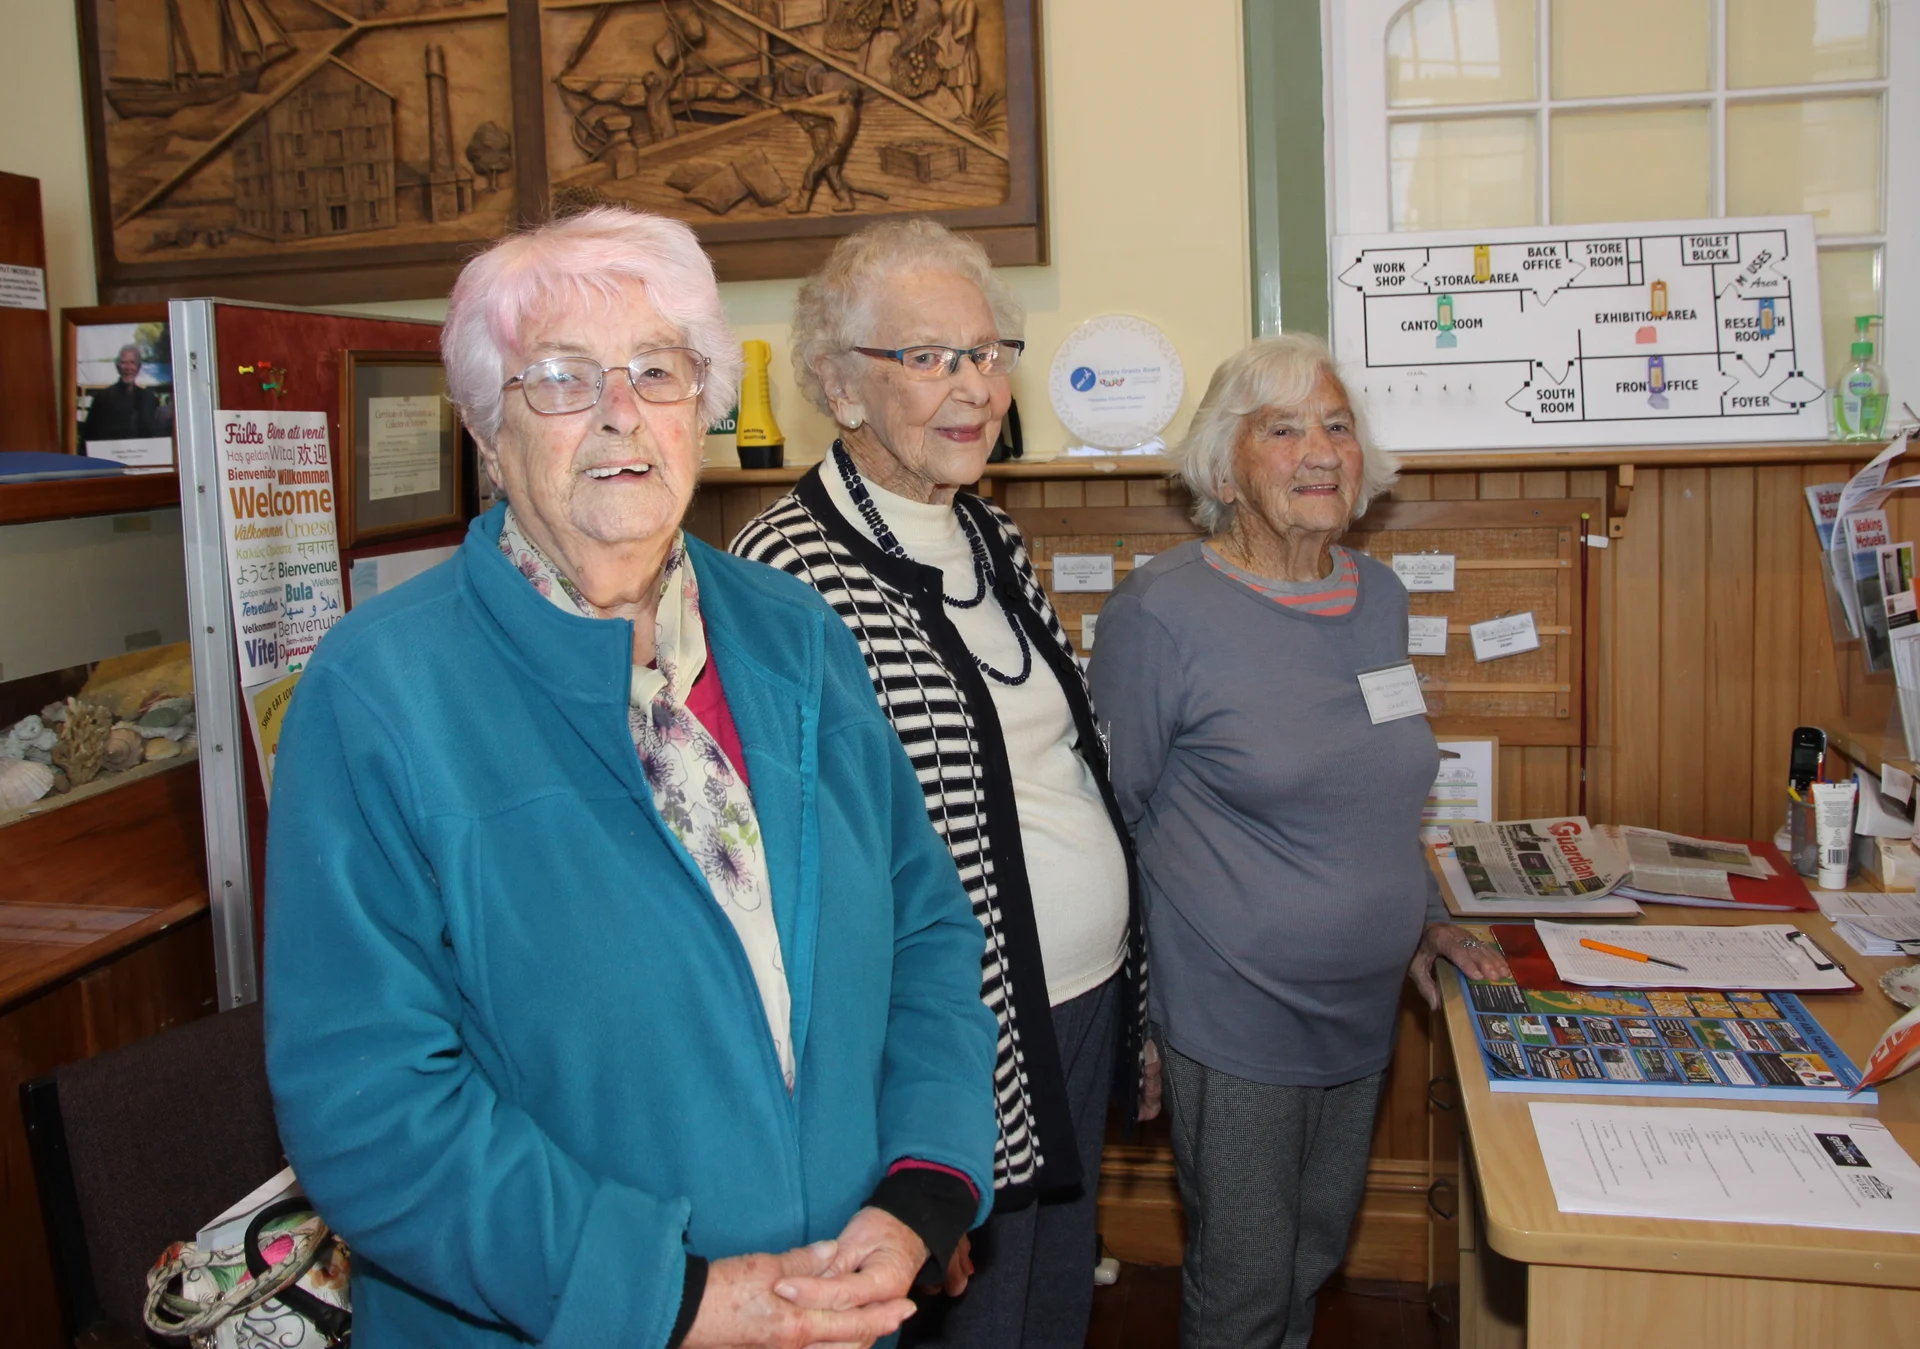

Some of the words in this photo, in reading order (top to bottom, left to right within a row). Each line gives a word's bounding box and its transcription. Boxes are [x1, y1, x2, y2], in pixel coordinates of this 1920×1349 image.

[1586, 243, 1622, 255] STORE
[1690, 236, 1729, 248] TOILET
[1528, 246, 1557, 258] BACK
[1692, 249, 1730, 261] BLOCK
[1373, 262, 1406, 274] WORK
[1523, 259, 1562, 271] OFFICE
[1590, 256, 1624, 268] ROOM
[1375, 276, 1406, 287] SHOP
[1434, 274, 1484, 286] STORAG
[1489, 273, 1519, 284] AREA
[1666, 309, 1698, 320] AREA
[1536, 389, 1575, 400] SOUTH
[1732, 396, 1770, 408] FOYER
[1541, 402, 1575, 413] ROOM
[225, 421, 264, 444] Fáilte
[267, 422, 286, 440] Bine
[302, 425, 326, 440] venit
[714, 419, 736, 431] AID
[245, 449, 269, 465] geldin
[268, 445, 296, 466] Witaj
[297, 443, 328, 466] 欢迎
[228, 466, 276, 481] Bienvenido
[229, 483, 332, 520] Welcome
[234, 522, 284, 541] Välkommen
[285, 518, 335, 539] Croeso
[1854, 518, 1883, 533] Walking
[1856, 532, 1887, 549] Motueka
[237, 561, 277, 586] ようこそ
[278, 560, 338, 579] Bienvenue
[285, 582, 313, 602] Bula
[245, 633, 279, 669] Vítej
[261, 707, 273, 730] SHOP
[271, 694, 283, 711] EAT
[1547, 821, 1596, 879] Guardian
[1810, 1035, 1838, 1059] TASMAN
